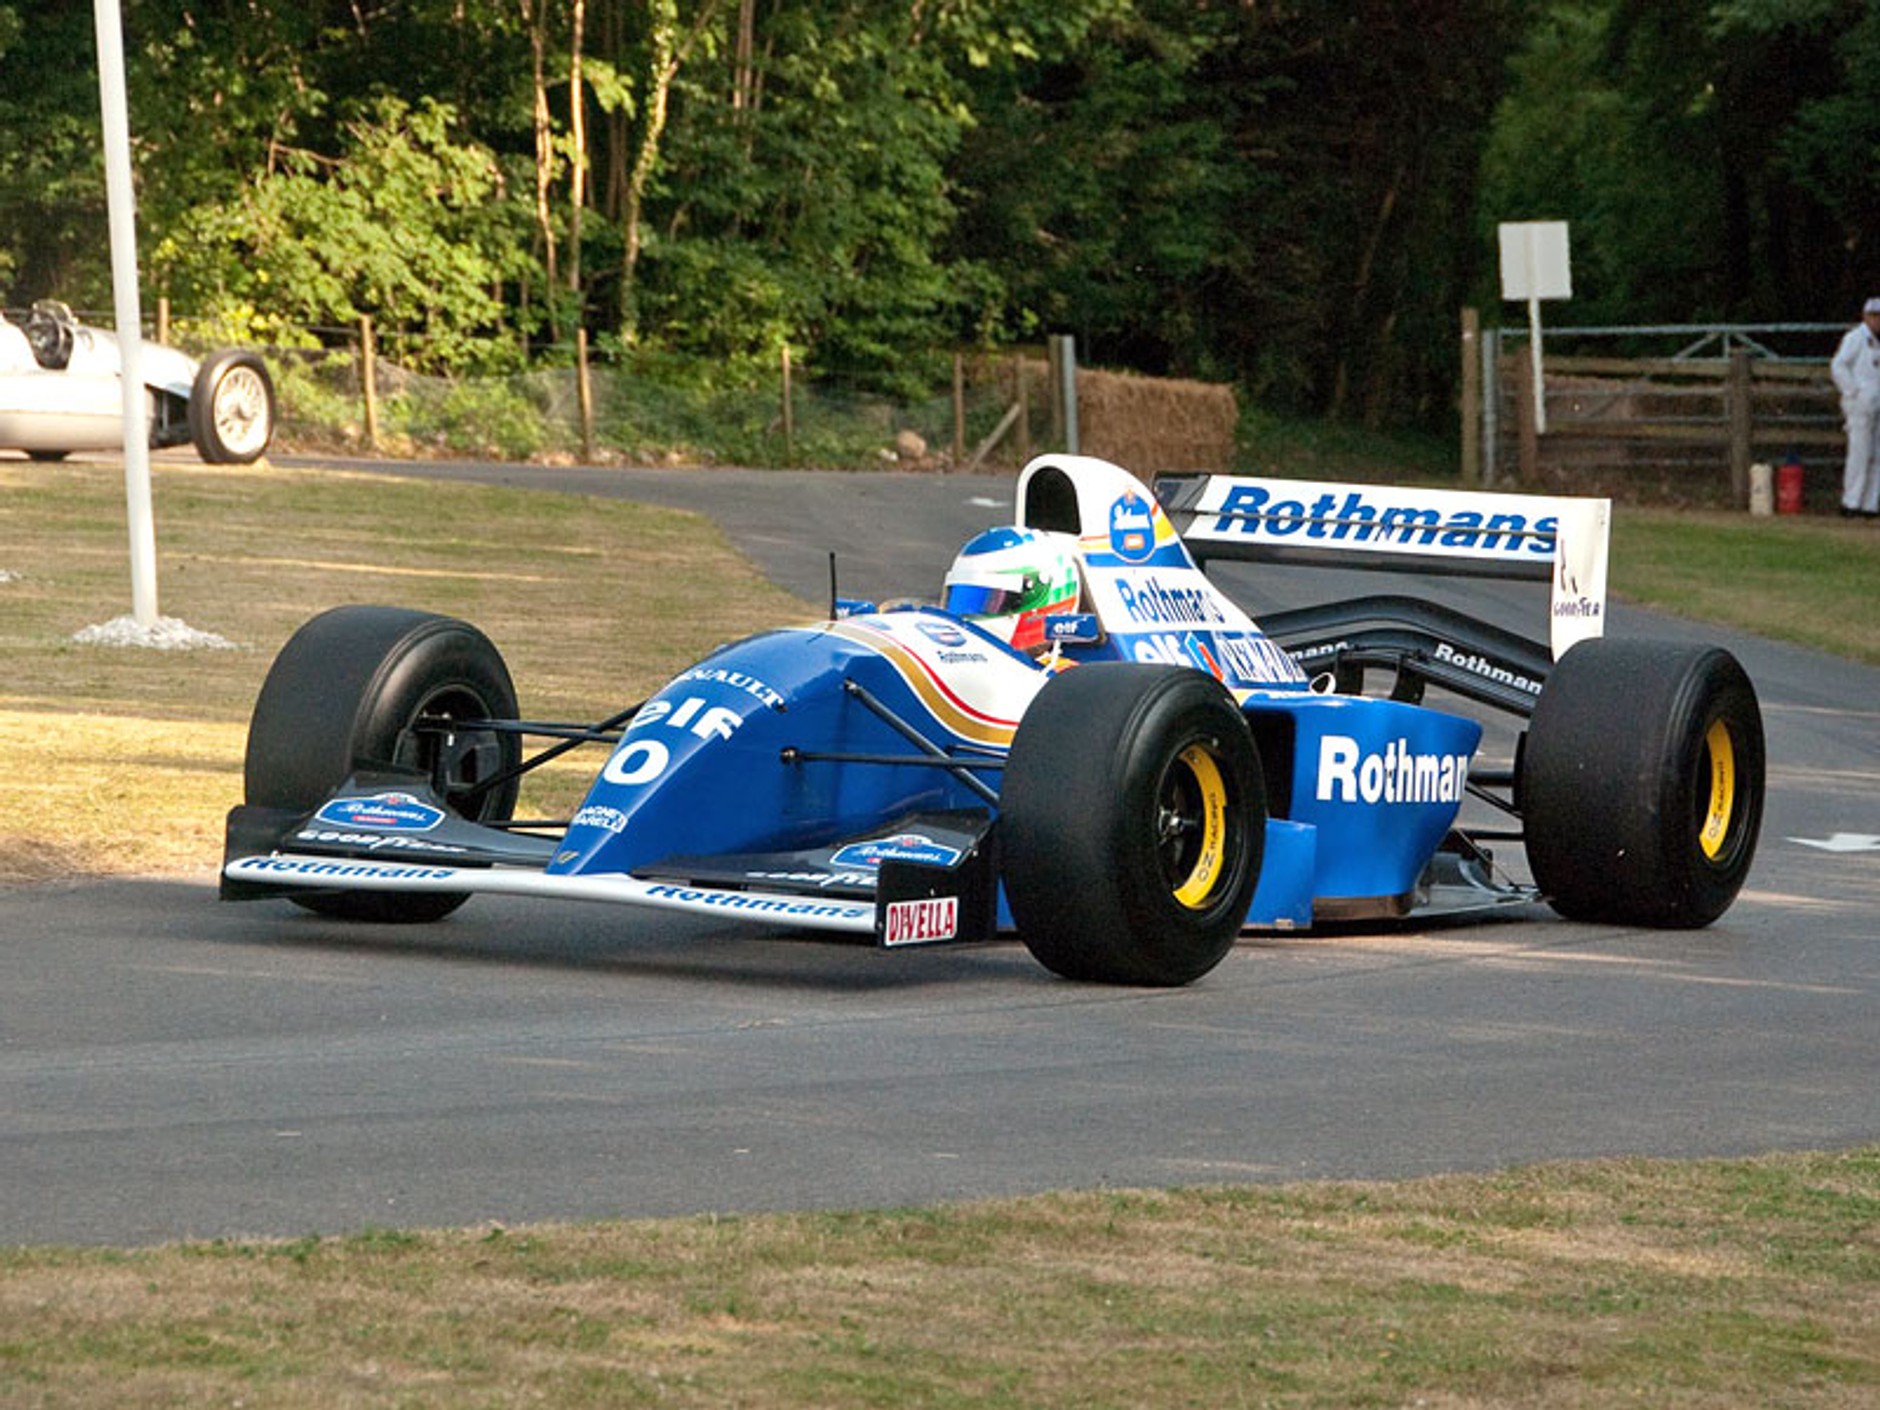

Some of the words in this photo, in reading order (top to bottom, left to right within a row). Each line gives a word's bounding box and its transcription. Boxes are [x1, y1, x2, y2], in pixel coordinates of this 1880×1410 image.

[1213, 485, 1559, 555] Rothmans
[1287, 640, 1349, 662] mans
[1434, 642, 1543, 695] Rothman
[627, 697, 744, 742] elf
[1316, 734, 1468, 803] Rothman
[645, 885, 868, 918] Rothmans
[889, 901, 956, 941] DIVELLA
